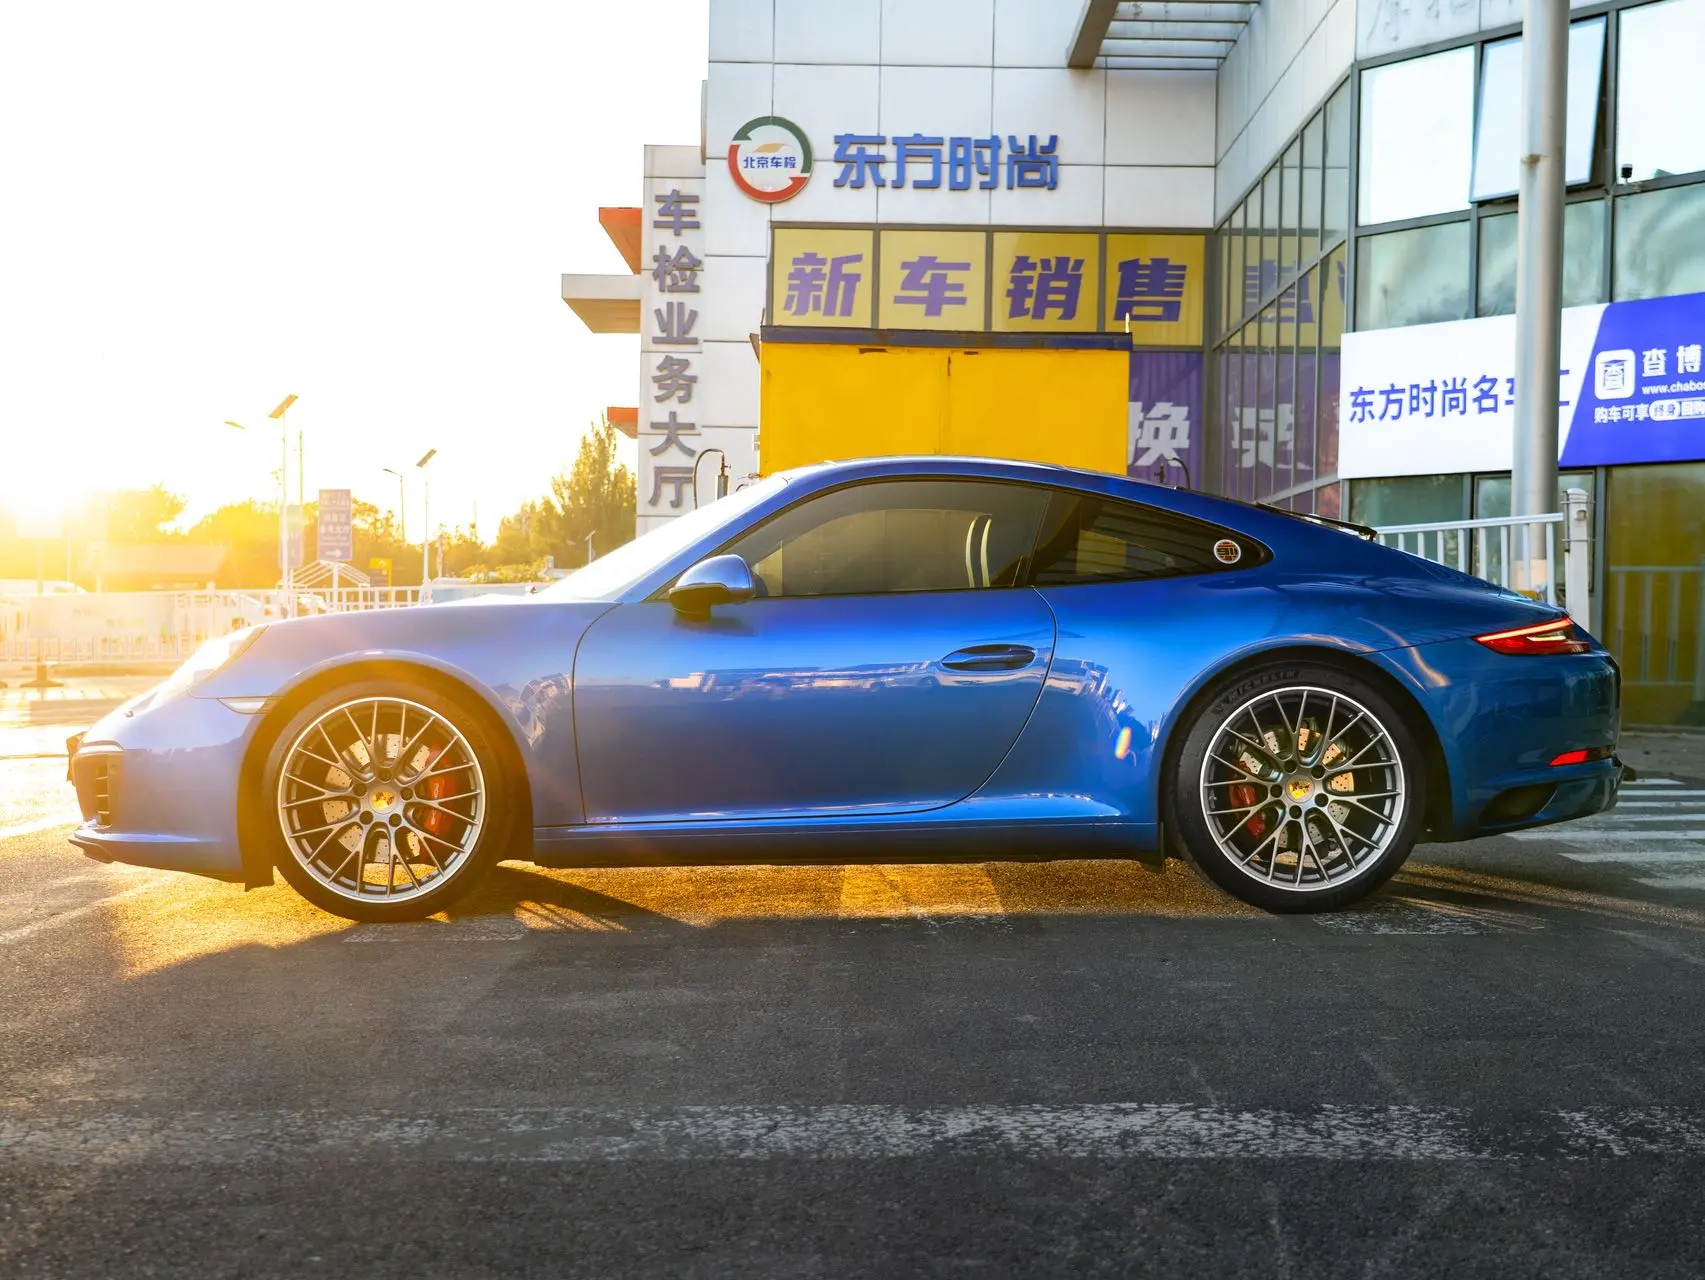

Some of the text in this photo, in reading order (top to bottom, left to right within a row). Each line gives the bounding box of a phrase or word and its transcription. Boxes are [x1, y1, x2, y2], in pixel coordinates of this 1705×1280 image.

[833, 133, 1059, 190] 东方时尚
[784, 250, 1188, 323] 新车销售
[648, 188, 702, 510] 车检业务大厅
